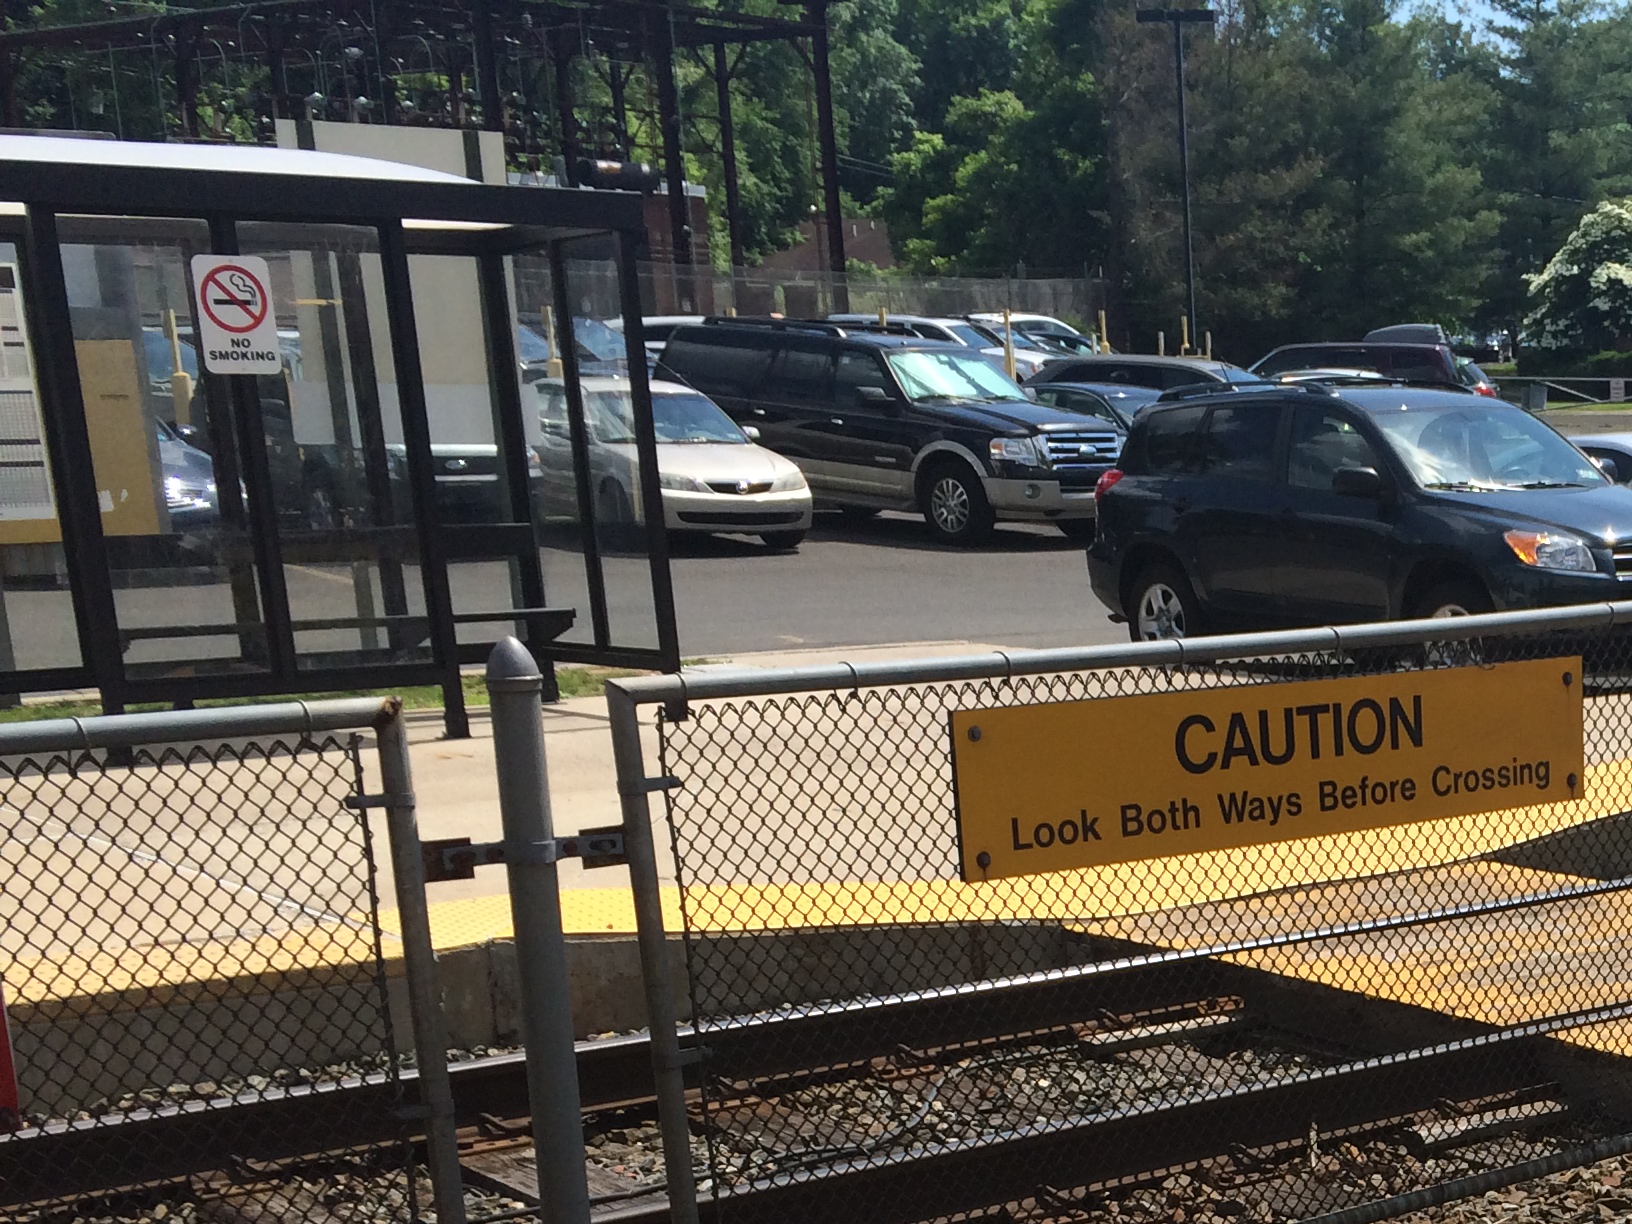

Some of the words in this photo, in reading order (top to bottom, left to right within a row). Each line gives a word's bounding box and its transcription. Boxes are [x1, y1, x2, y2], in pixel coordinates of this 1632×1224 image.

[209, 350, 276, 361] SMOKING
[230, 338, 251, 349] NO
[1175, 695, 1424, 775] CAUTION
[1011, 810, 1102, 851] Look
[1121, 799, 1202, 838] Both
[1218, 789, 1303, 827] Ways
[1319, 775, 1417, 813] Before
[1432, 760, 1552, 798] Crossing
